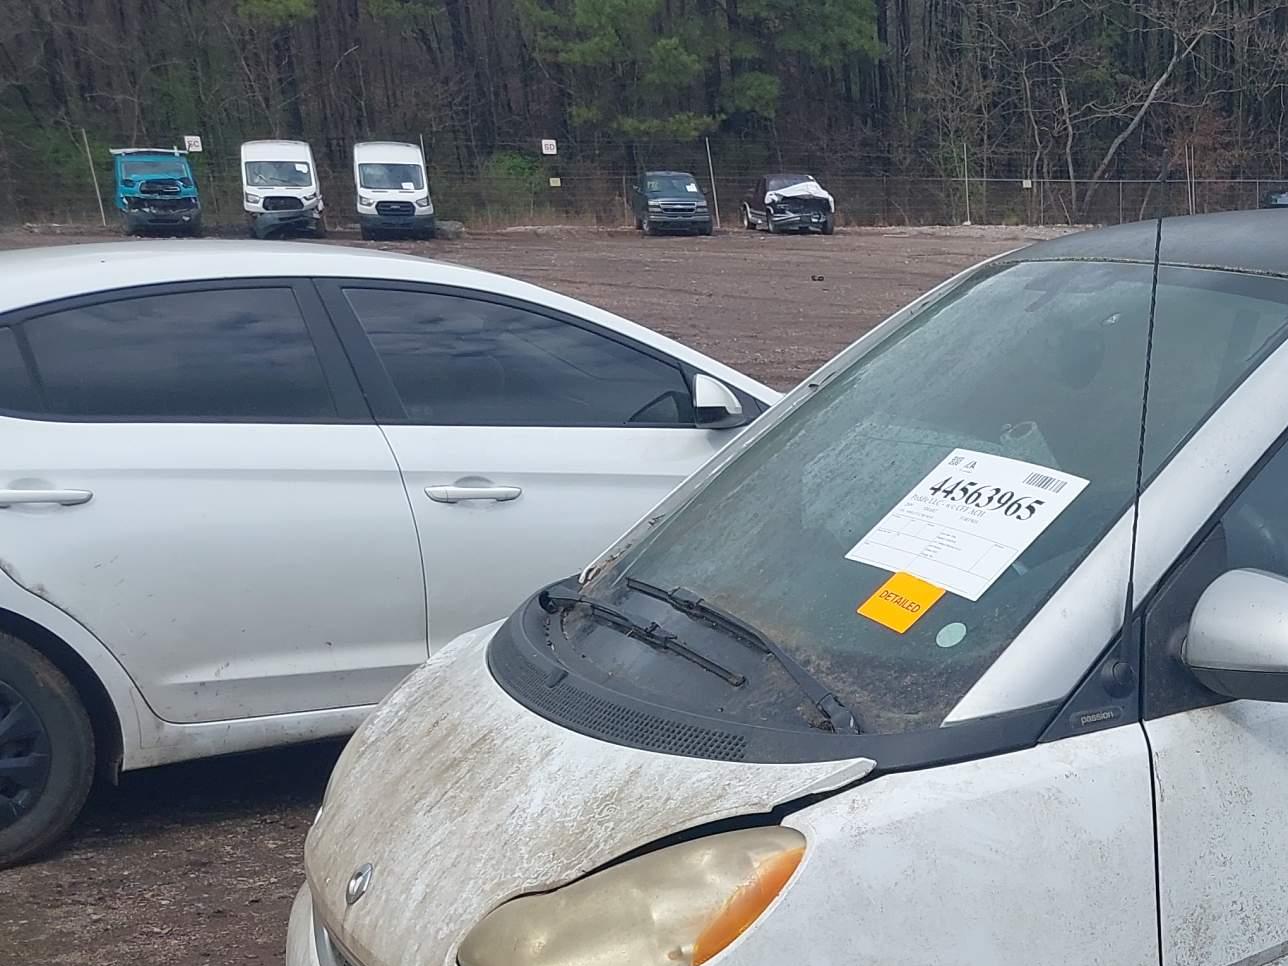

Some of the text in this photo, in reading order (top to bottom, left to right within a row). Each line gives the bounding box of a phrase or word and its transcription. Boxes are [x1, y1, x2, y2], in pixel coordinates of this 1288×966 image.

[929, 476, 1046, 521] 44563965
[879, 589, 921, 614] DETAILED
[1080, 711, 1114, 726] passion
